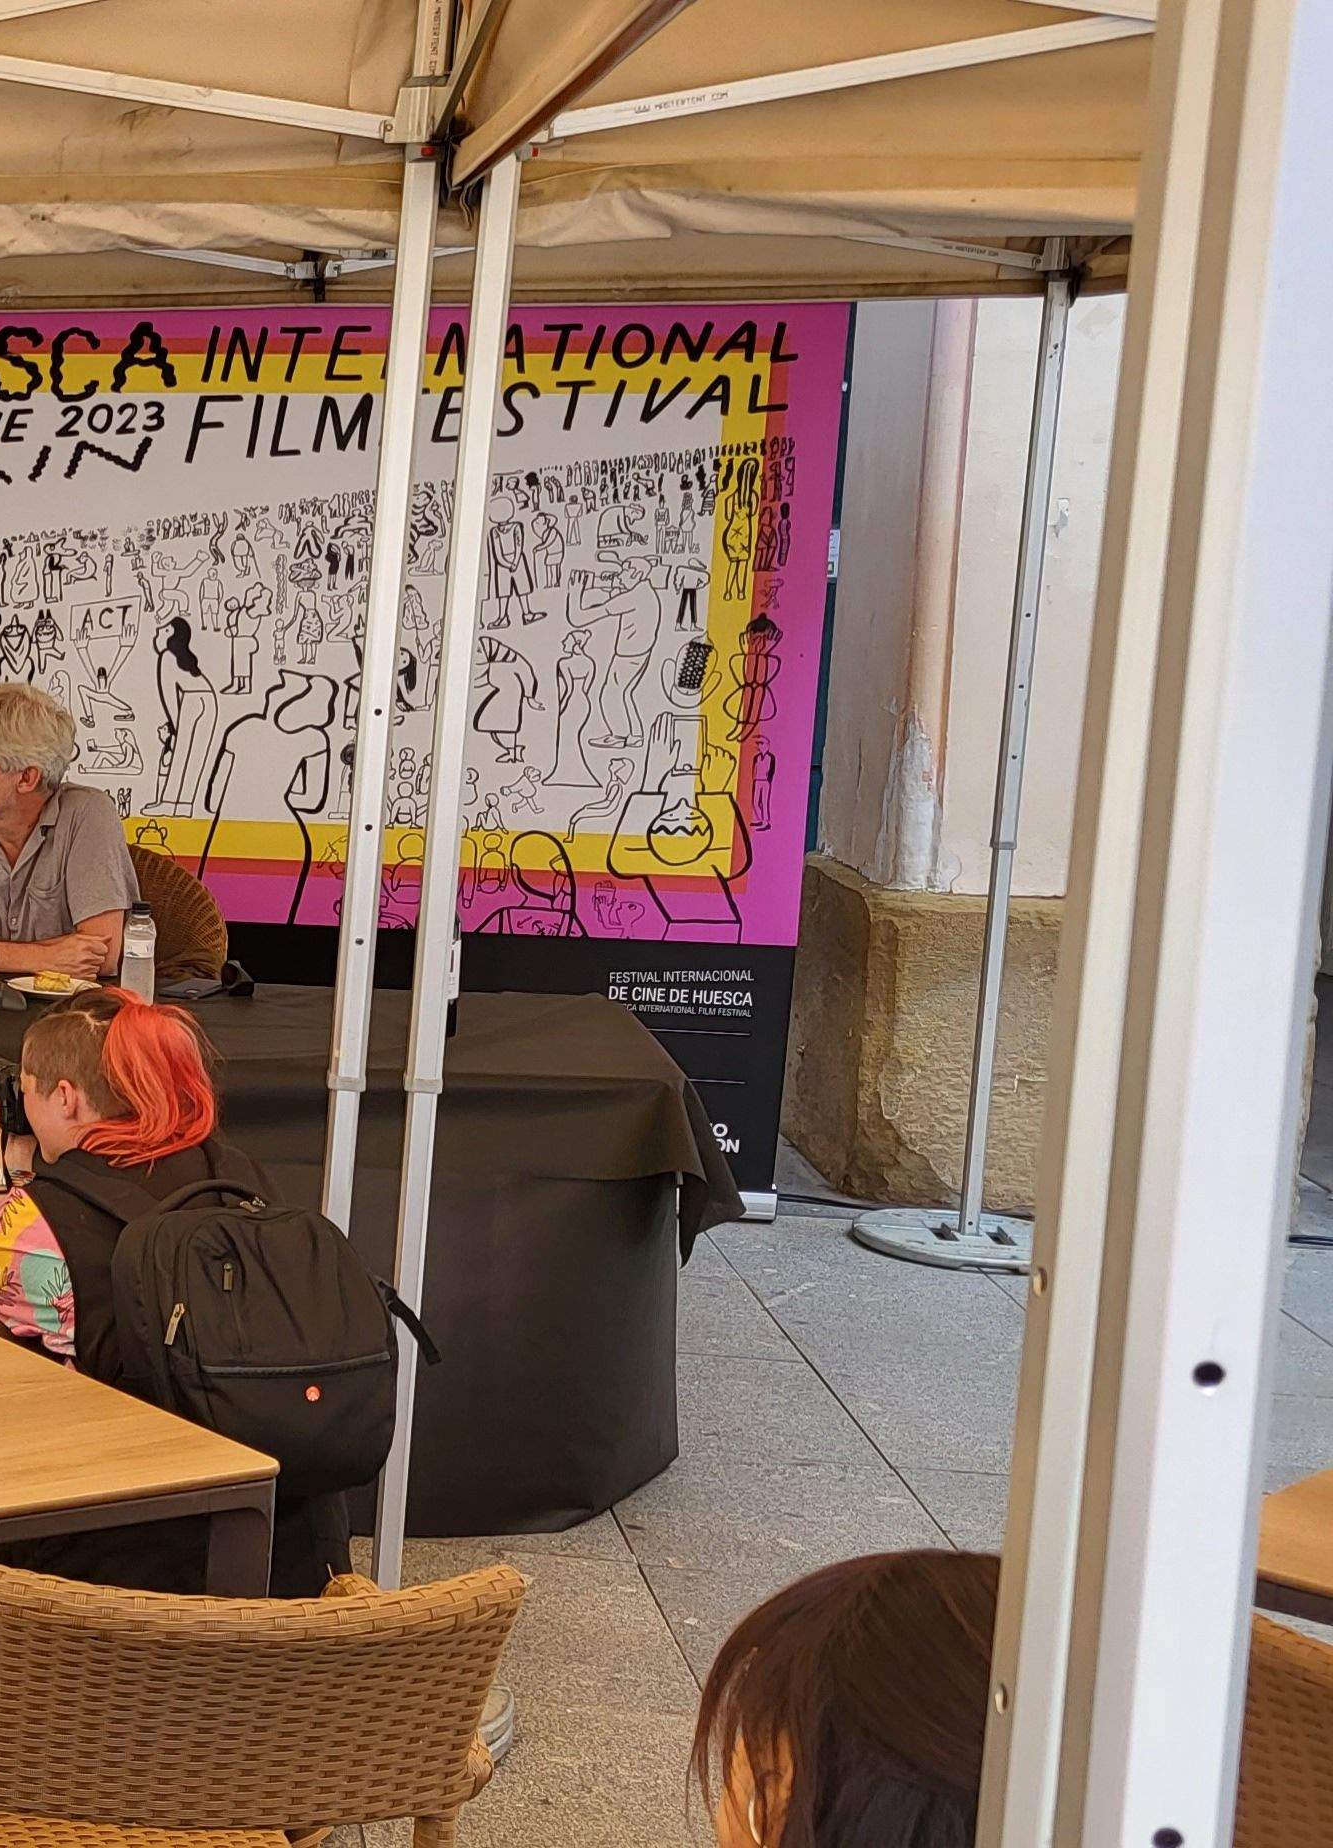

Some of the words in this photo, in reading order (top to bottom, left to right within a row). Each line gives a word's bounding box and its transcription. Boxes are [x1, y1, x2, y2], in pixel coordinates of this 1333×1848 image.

[200, 320, 800, 384] INTENATIONAL
[54, 401, 166, 438] 2023
[81, 604, 133, 636] ACT
[609, 971, 661, 984] FESTIVAL
[663, 969, 755, 983] INTERNACIONAL
[608, 986, 629, 1000] DE
[632, 987, 666, 1002] CINE
[669, 988, 690, 1004] DE
[692, 990, 753, 1006] HUESCA
[638, 1004, 696, 1015] INTERNATIONAL
[698, 1006, 716, 1016] FILM
[718, 1008, 752, 1017] FESTIVAL
